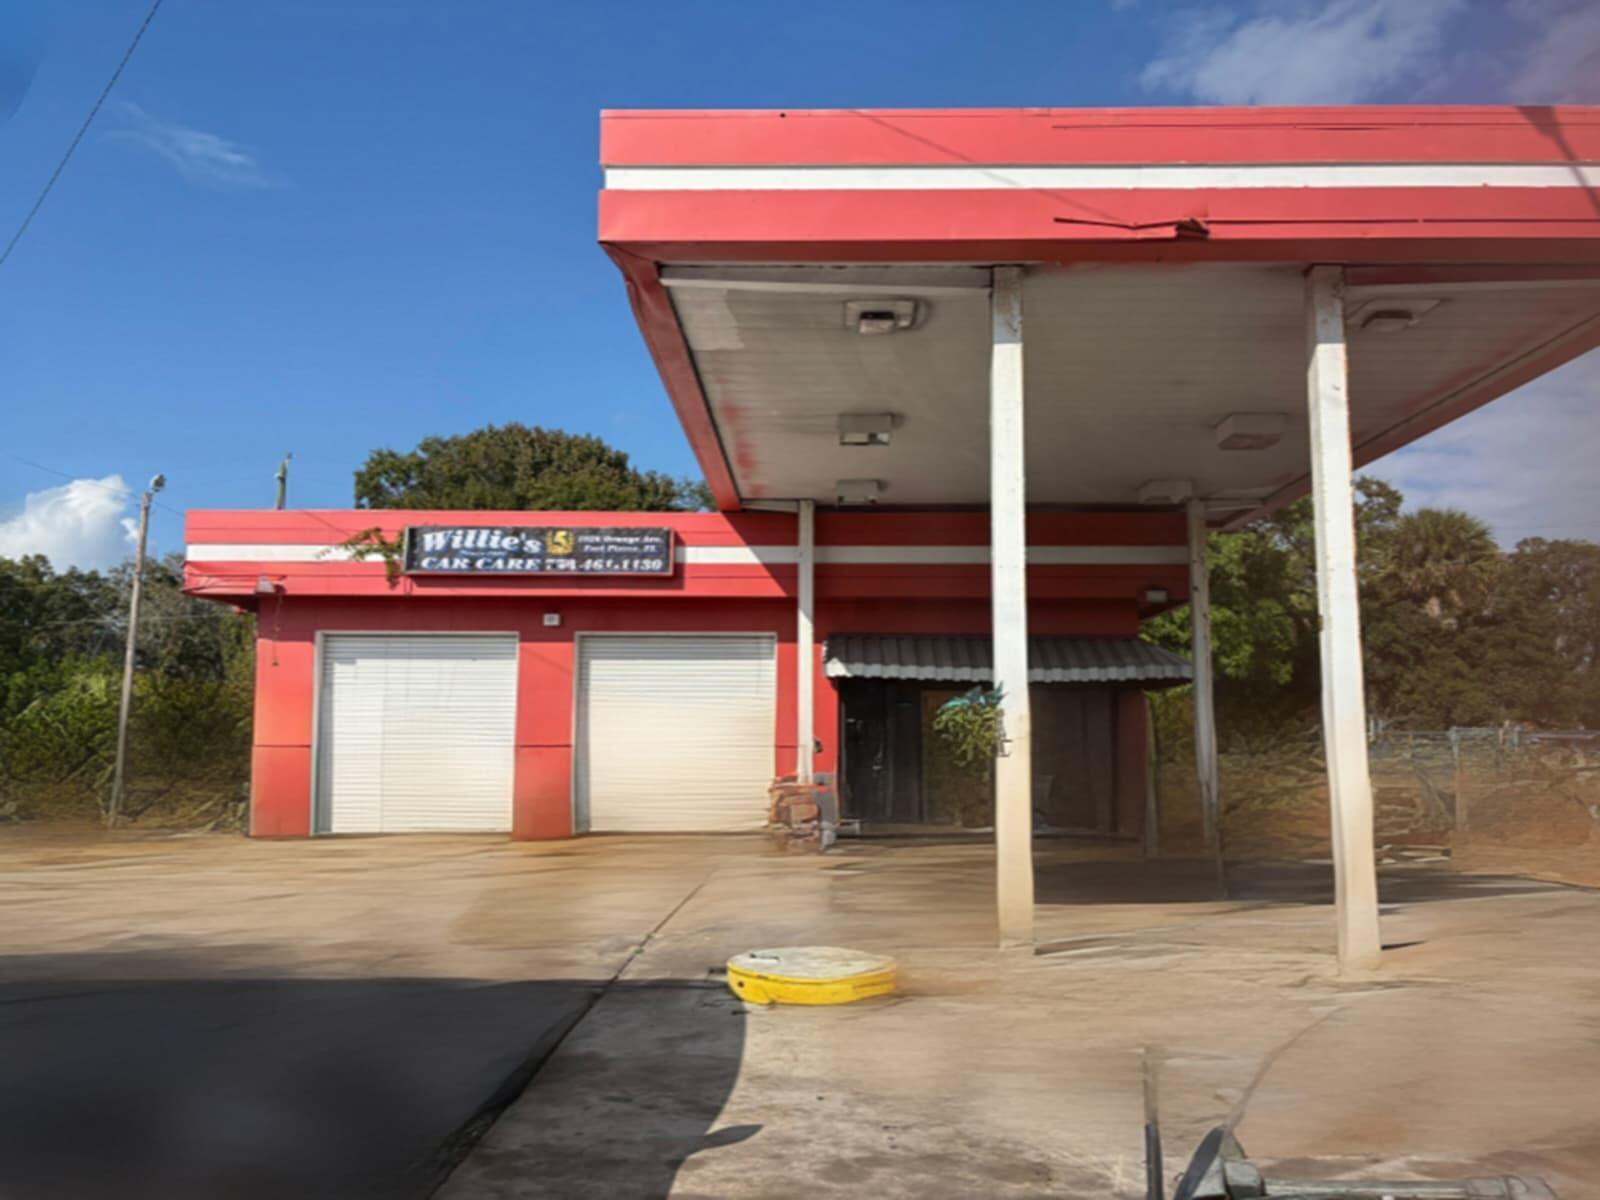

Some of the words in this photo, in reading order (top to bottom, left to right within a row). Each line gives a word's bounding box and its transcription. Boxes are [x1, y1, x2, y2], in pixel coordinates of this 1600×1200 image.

[423, 529, 543, 553] Willie's
[421, 557, 471, 569] CAR
[475, 557, 541, 569] CARE
